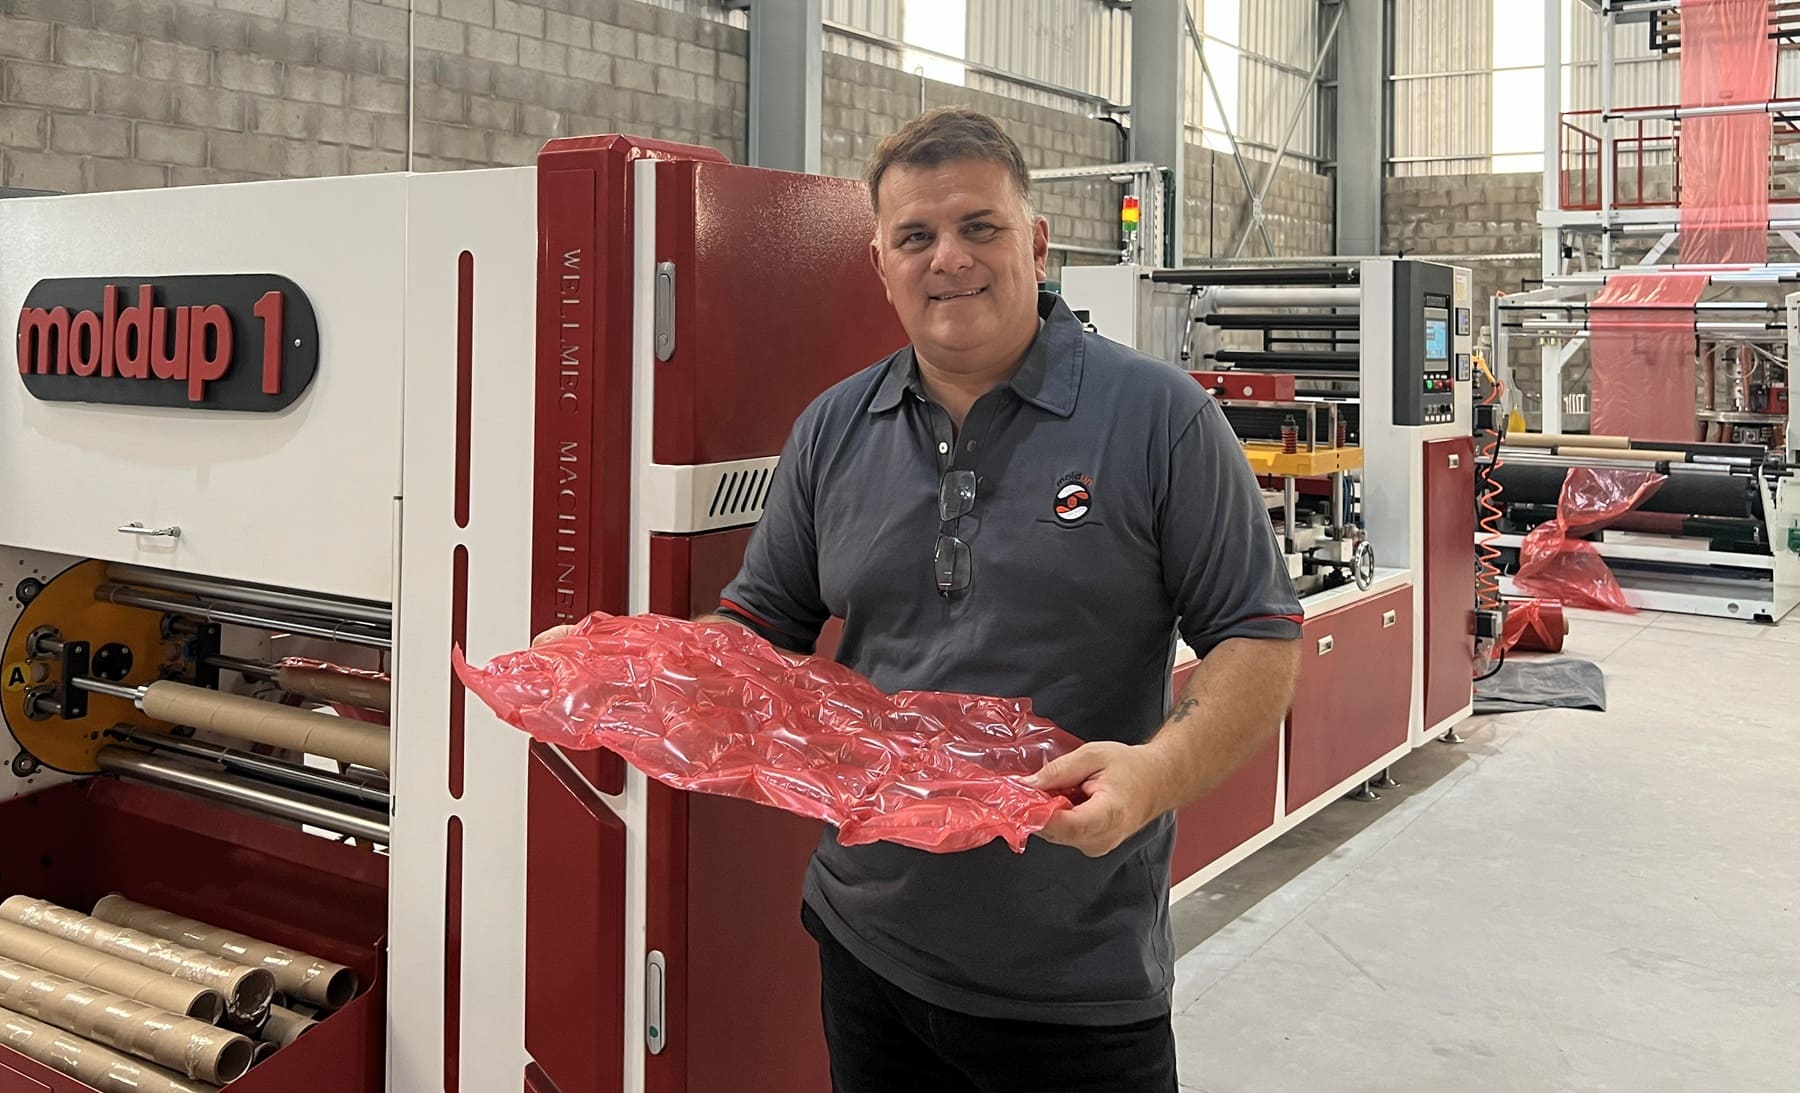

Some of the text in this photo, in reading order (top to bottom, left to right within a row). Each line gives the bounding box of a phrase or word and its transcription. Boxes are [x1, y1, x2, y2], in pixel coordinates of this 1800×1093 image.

[19, 284, 284, 401] moldup 1
[559, 248, 581, 414] WELLMEC
[8, 666, 25, 686] A
